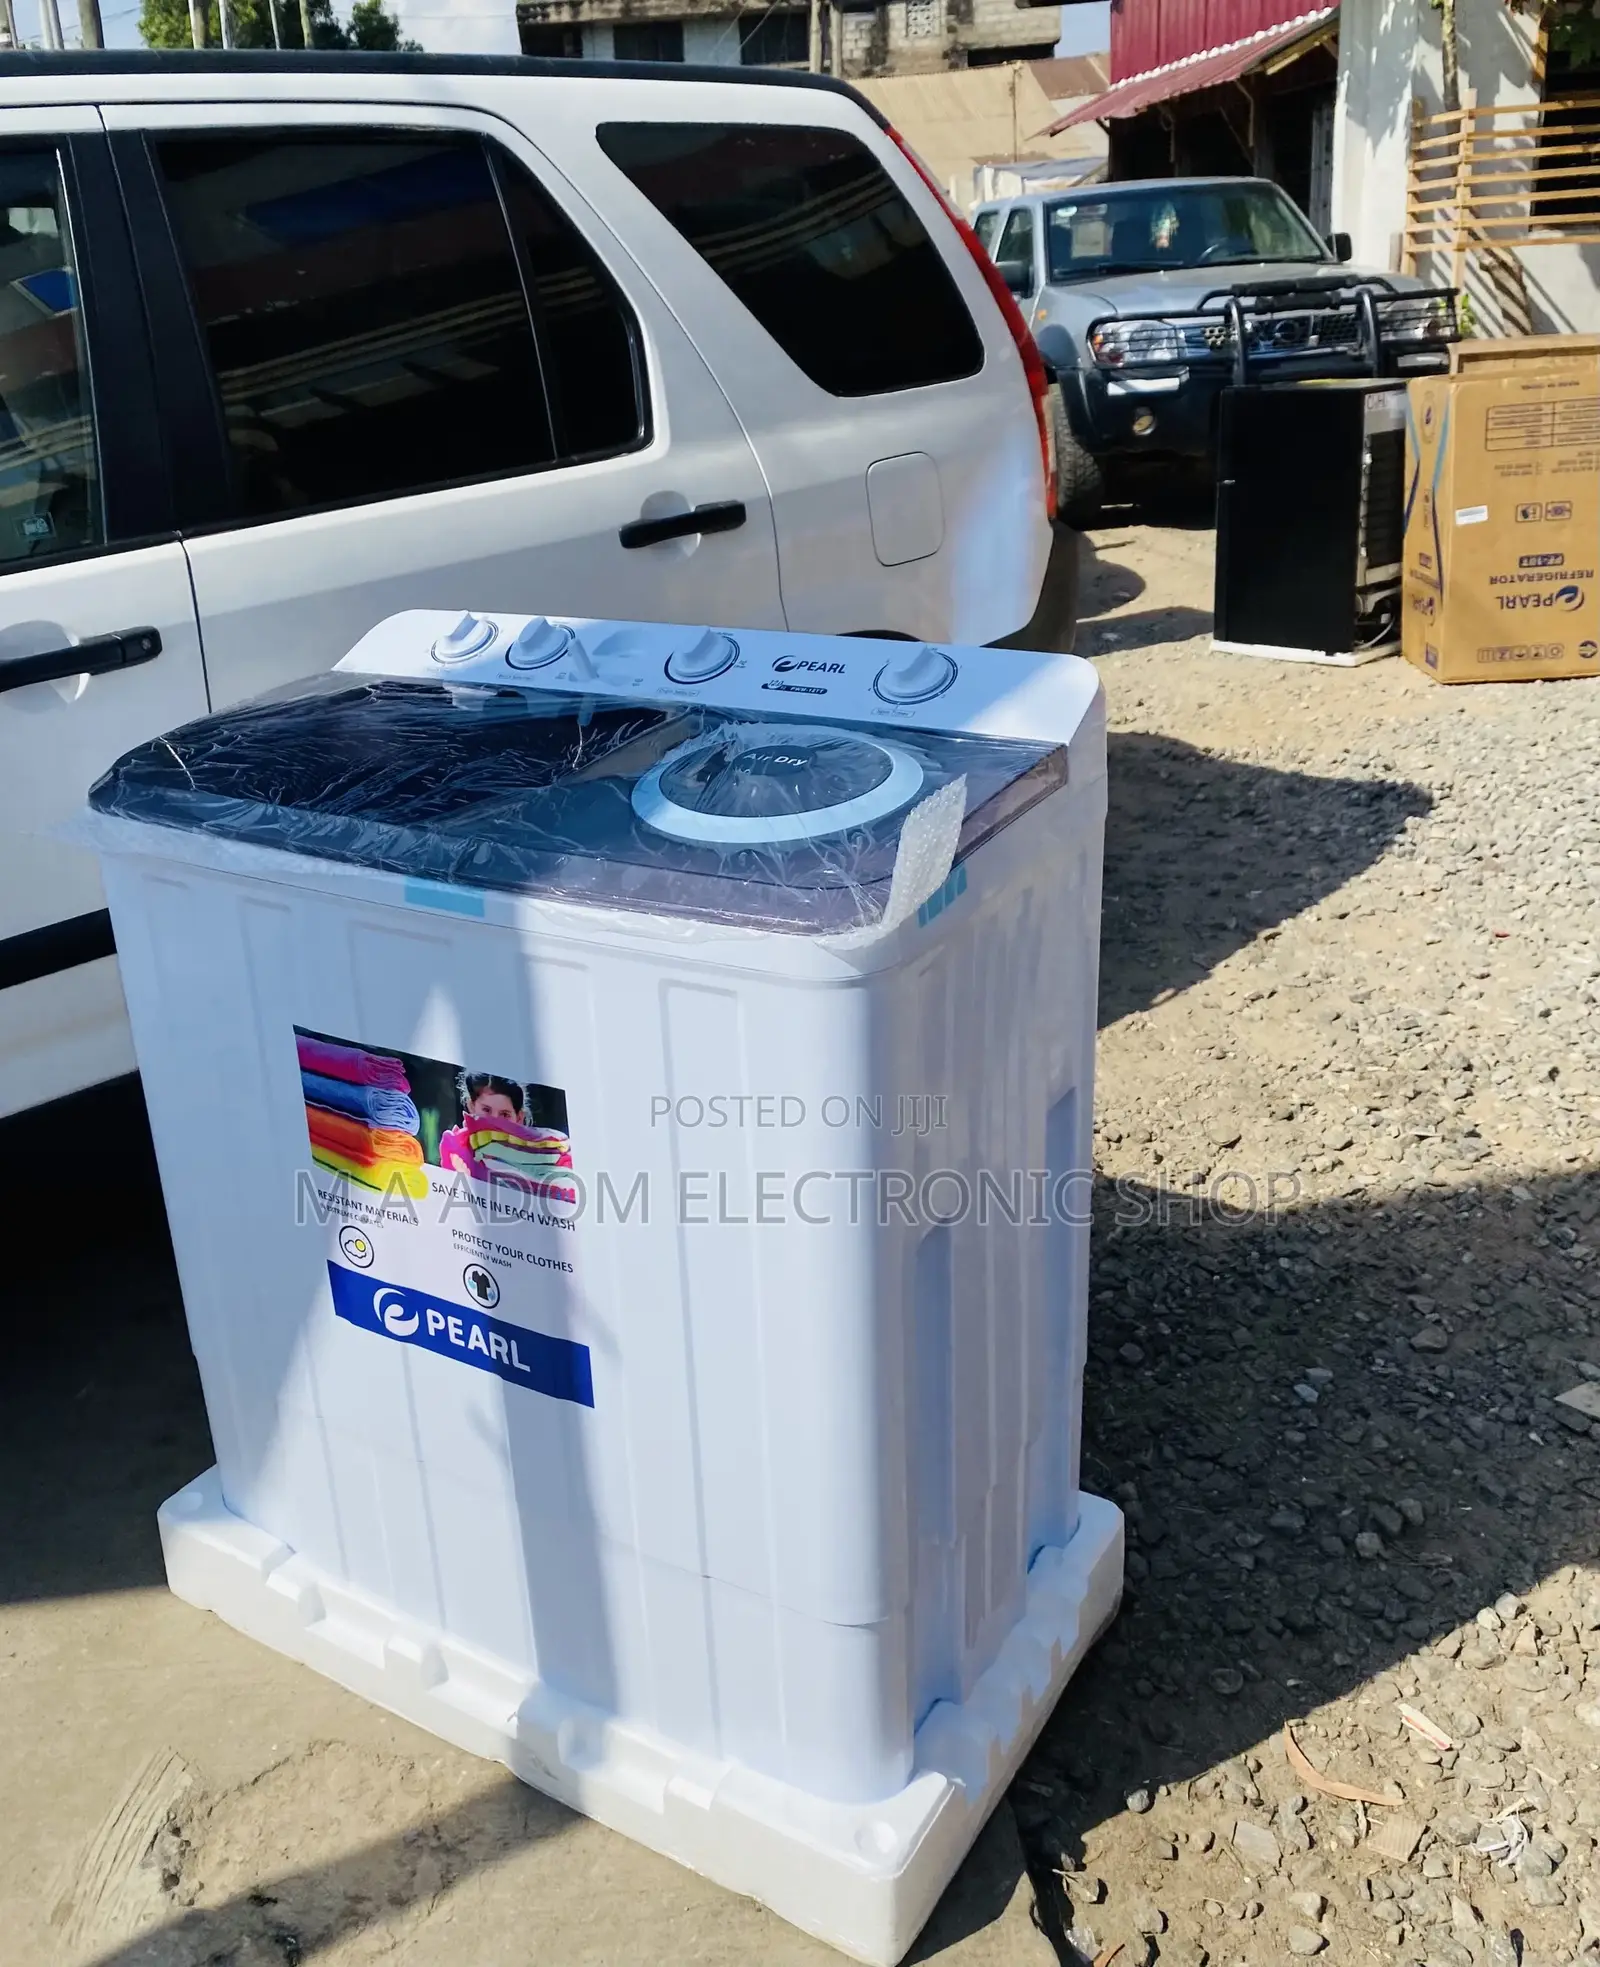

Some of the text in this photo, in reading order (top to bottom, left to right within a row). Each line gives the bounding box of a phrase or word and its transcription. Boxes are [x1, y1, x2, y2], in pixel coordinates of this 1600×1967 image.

[1489, 569, 1595, 585] REFRIGERATOR
[1495, 592, 1554, 609] PEARL
[797, 660, 846, 674] PEARL
[774, 756, 808, 767] Dry
[317, 1189, 419, 1227] RESISTANT MATERIALS
[431, 1181, 576, 1231] SAVE TIME IN EACH WASH
[451, 1229, 574, 1273] PROTECT YOUR CLOTHES
[453, 1242, 512, 1268] EFFICIENTLY WASH
[425, 1308, 531, 1373] PEARL
